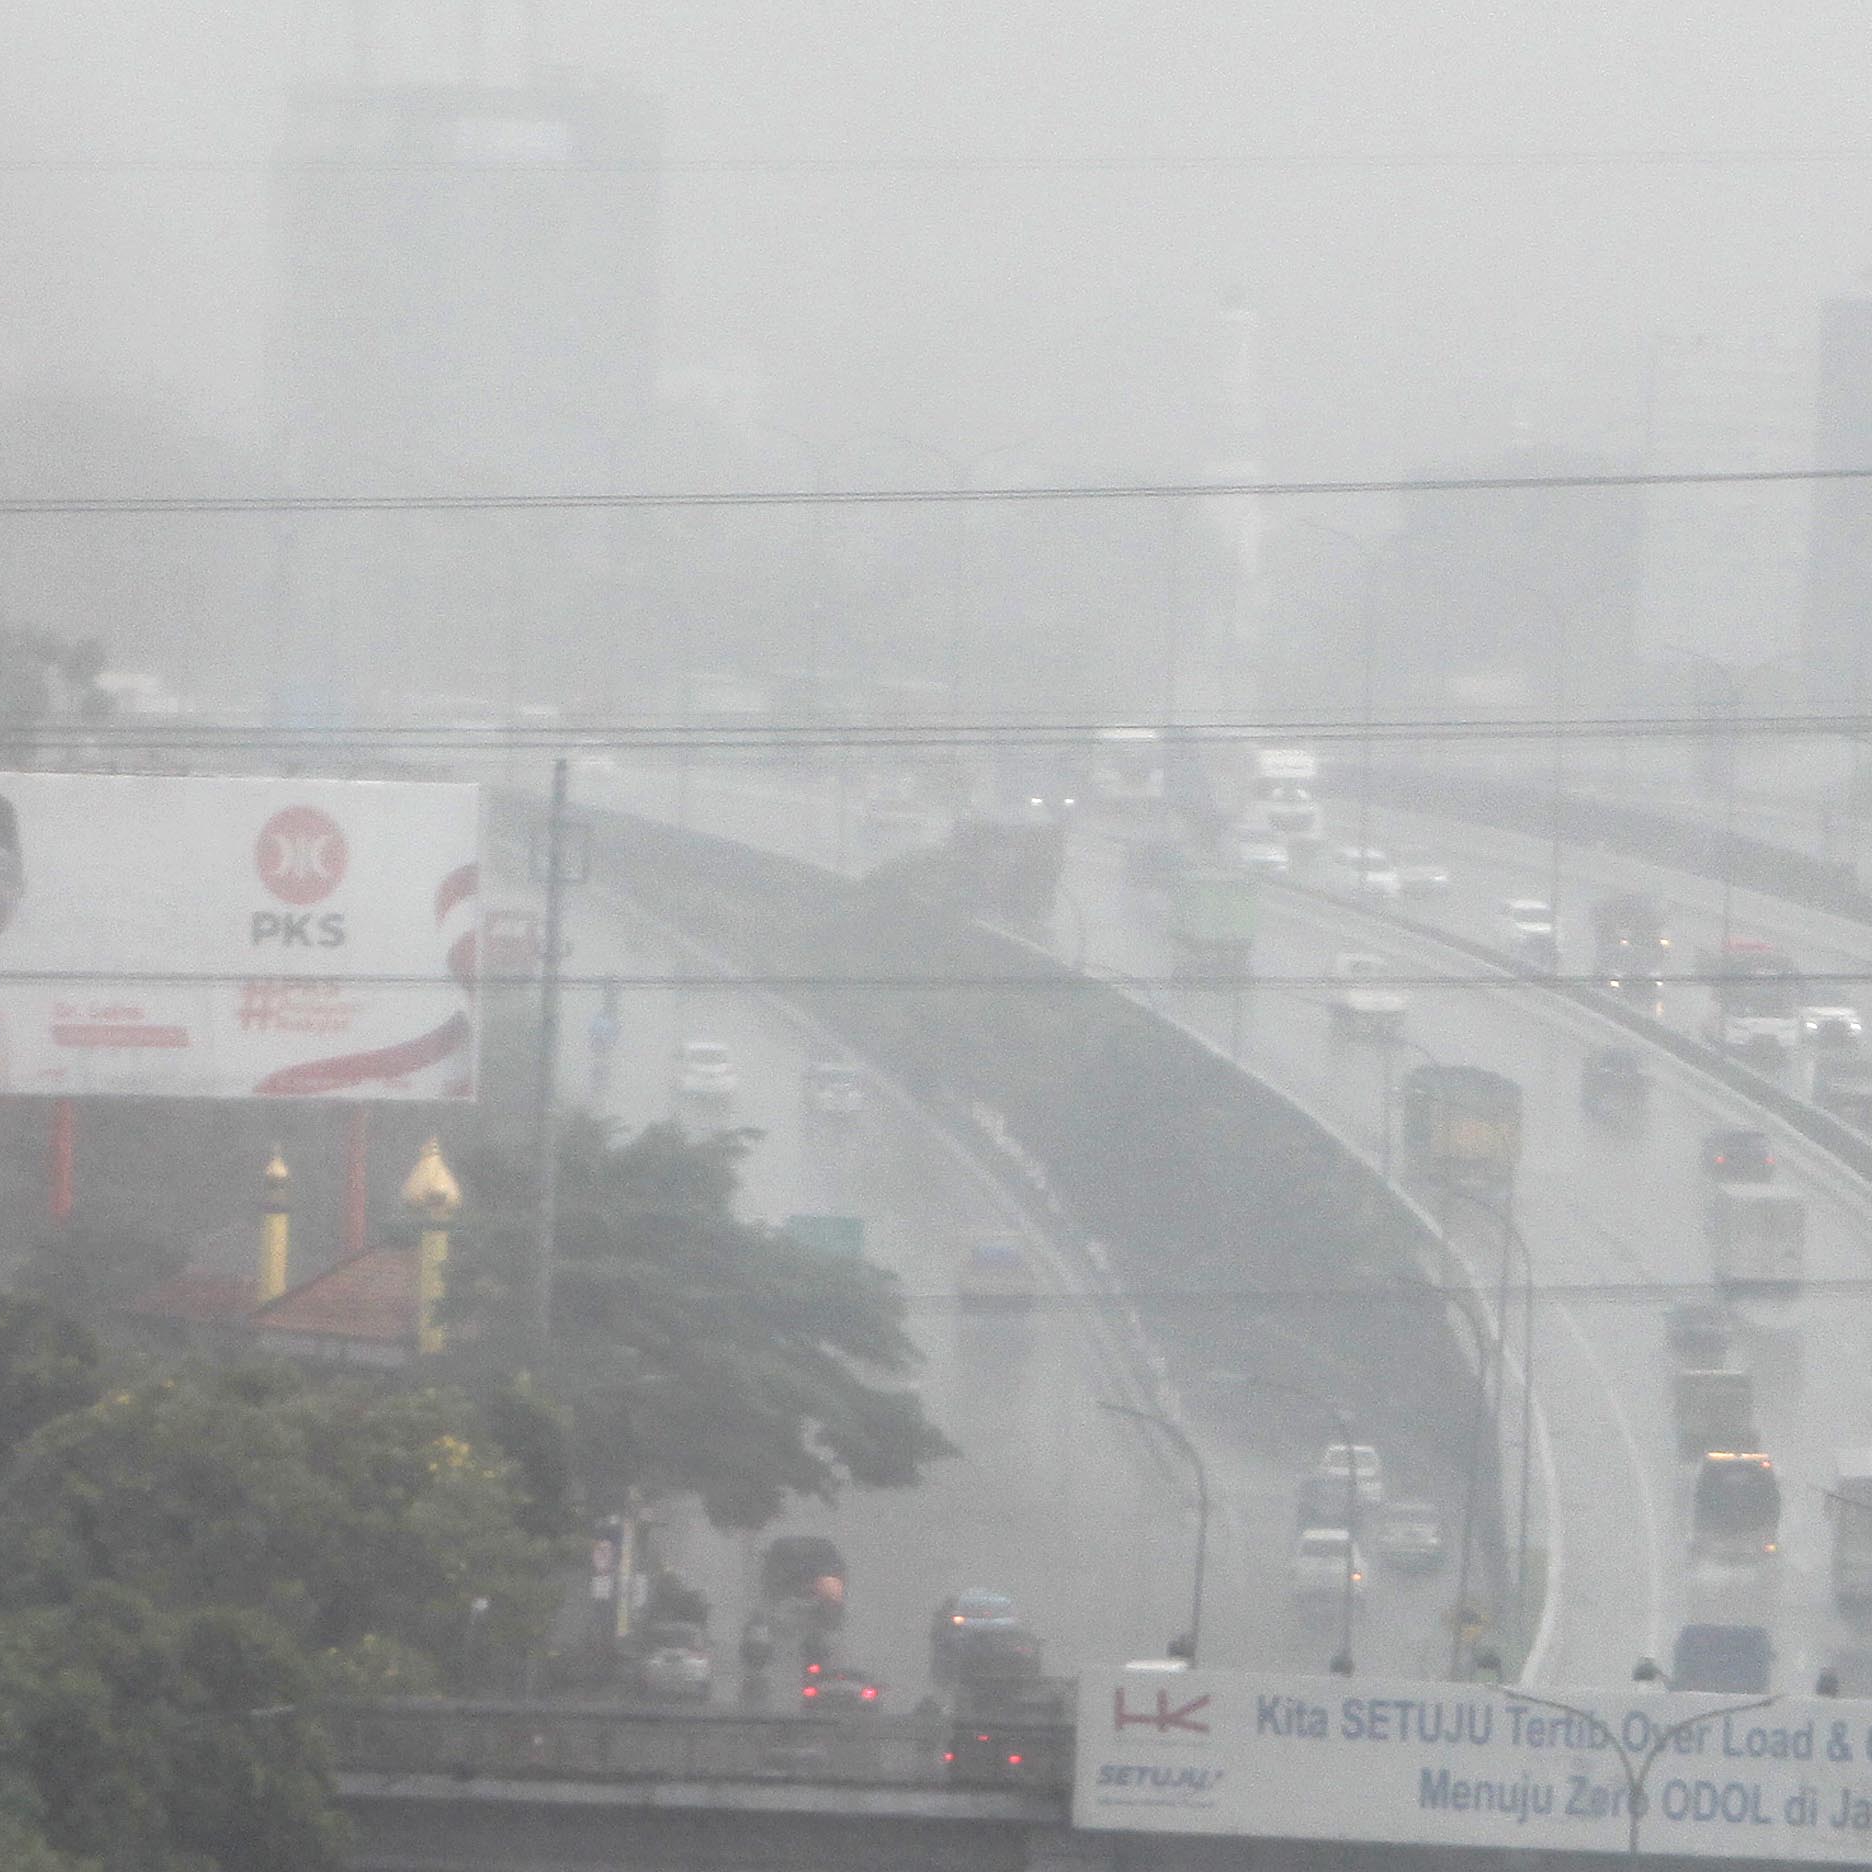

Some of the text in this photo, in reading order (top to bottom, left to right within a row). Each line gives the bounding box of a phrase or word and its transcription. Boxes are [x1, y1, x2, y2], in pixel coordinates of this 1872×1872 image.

[250, 910, 347, 949] PKS
[1256, 1695, 1327, 1741] Kita
[1341, 1697, 1493, 1746] SETUJU
[1507, 1703, 1608, 1752] Tertib
[1622, 1711, 1709, 1758] Over
[1722, 1714, 1814, 1760] Load
[1826, 1720, 1853, 1762] &
[1418, 1767, 1554, 1824] Menuju
[1662, 1780, 1771, 1826] ODOL
[1784, 1788, 1817, 1828] di
